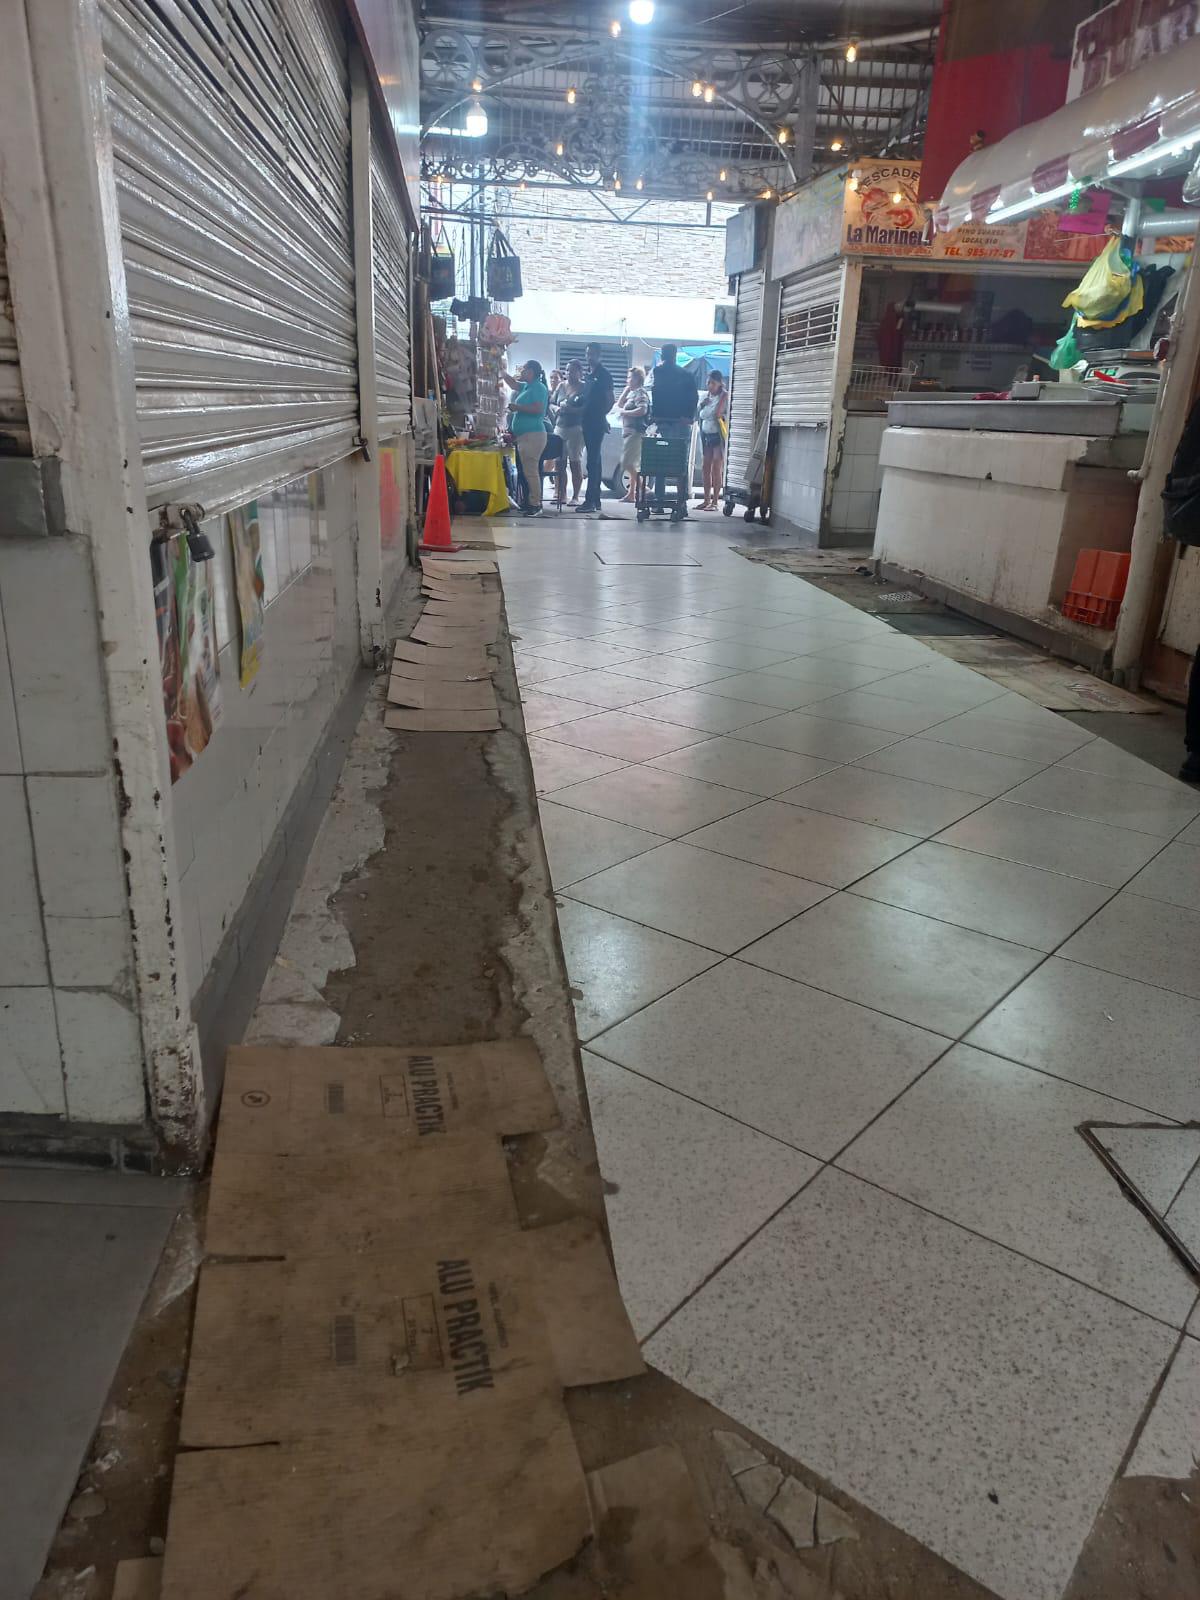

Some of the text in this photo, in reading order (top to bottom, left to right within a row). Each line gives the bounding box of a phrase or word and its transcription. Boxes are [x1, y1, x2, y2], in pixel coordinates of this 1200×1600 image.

[847, 224, 862, 243] La
[407, 1055, 447, 1136] ALU PRACTIK
[436, 1259, 495, 1396] ALU PRACTIK
